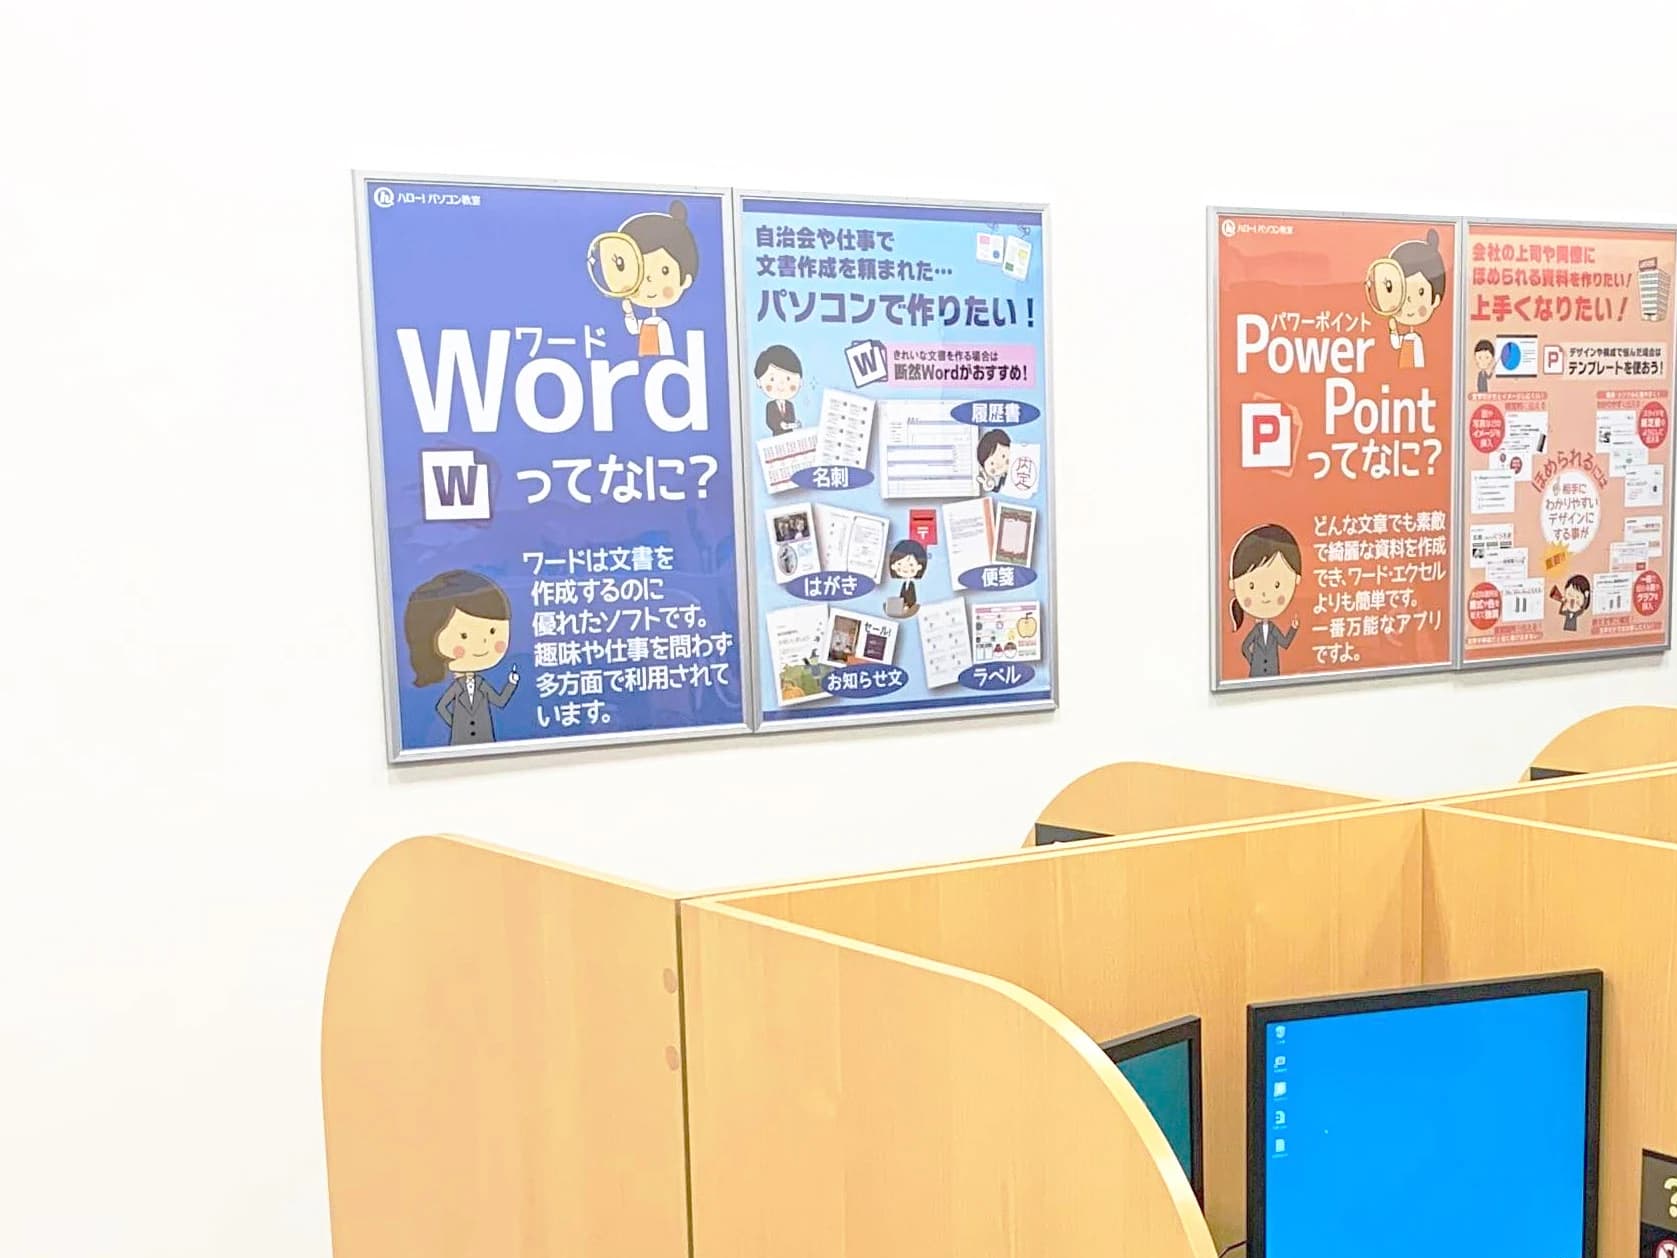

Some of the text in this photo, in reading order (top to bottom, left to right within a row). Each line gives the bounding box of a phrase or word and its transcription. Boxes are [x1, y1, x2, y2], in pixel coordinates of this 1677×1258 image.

[756, 224, 894, 252] 自治会や仕事で
[757, 288, 1035, 328] パソコンで作りたい！
[1270, 310, 1371, 332] パワーポイント
[1470, 294, 1628, 322] 上手くなりたい！
[515, 325, 606, 359] ワード
[893, 350, 999, 362] きれいな文書を作る場合は
[1236, 313, 1375, 374] Power
[853, 352, 879, 377] W
[1548, 351, 1559, 369] P
[396, 328, 709, 434] Word
[971, 402, 1021, 423] 履歴書
[1325, 376, 1436, 435] Point
[1252, 414, 1281, 455] P
[1307, 437, 1442, 480] ってなに?
[1531, 448, 1608, 493] ほめられるには
[432, 465, 478, 507] W
[516, 453, 719, 504] ってなに?
[813, 466, 849, 488] 名刺
[1545, 497, 1598, 510] わかりやすい
[1313, 510, 1446, 536] どんな文章でも素敵
[1548, 512, 1595, 525] デザインに
[1553, 526, 1589, 540] する事が
[523, 545, 674, 576] ワードは文書を
[1313, 536, 1447, 562] で綺麗な資料を作成
[804, 575, 857, 597] はがき
[982, 567, 1015, 587] 便箋
[531, 577, 664, 606] 作成するのに
[1313, 588, 1417, 614] よりも簡単です。
[532, 604, 706, 638] 優れたソフトです。
[1312, 610, 1441, 638] 一番万能なアプリ
[534, 632, 732, 667] 趣味や仕事を問わず
[1312, 644, 1360, 664] ですよ。
[536, 663, 729, 697] 多方面で利用されて
[827, 668, 902, 692] お知らせ文
[973, 666, 1022, 687] ラベル
[537, 700, 611, 728] います。
